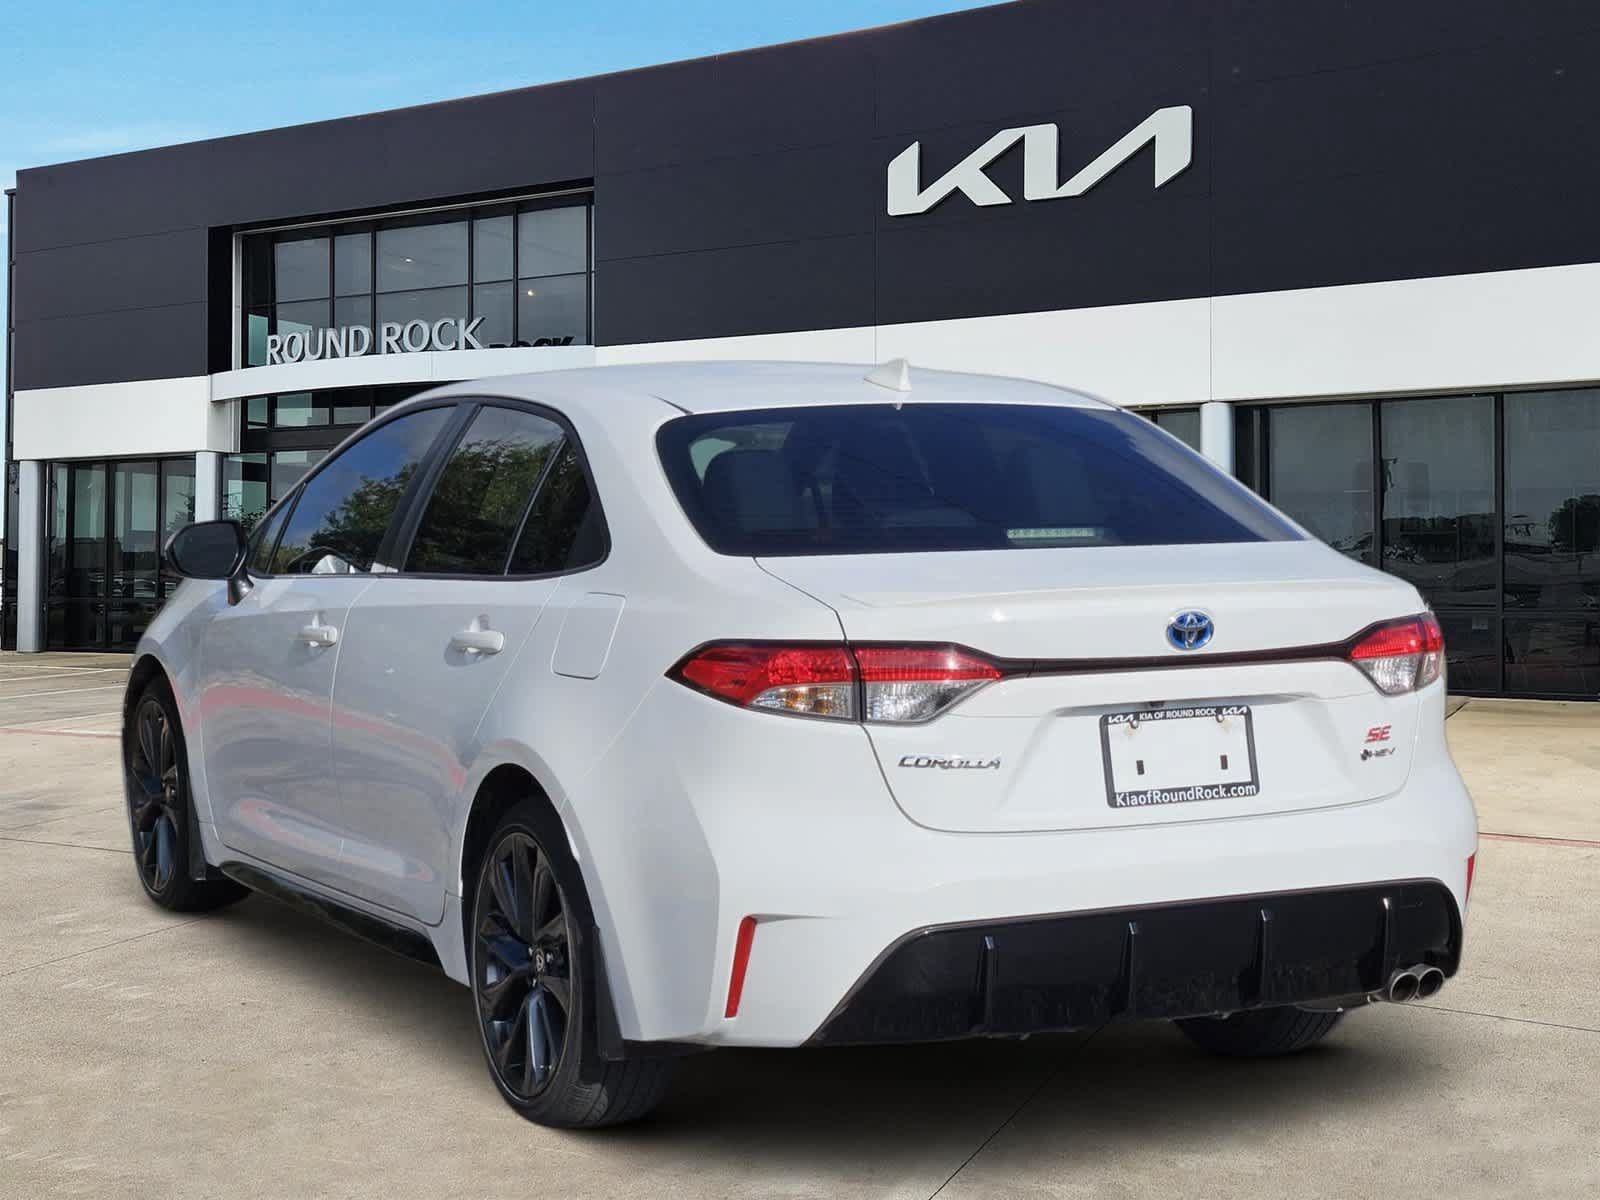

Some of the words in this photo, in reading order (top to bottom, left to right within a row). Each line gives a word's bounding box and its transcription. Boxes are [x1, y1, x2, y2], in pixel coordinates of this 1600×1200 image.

[887, 105, 1193, 216] KIA
[266, 324, 373, 365] ROUND
[380, 316, 484, 355] ROCK
[1139, 712, 1154, 721] KIA
[1154, 711, 1165, 719] OF
[1166, 709, 1194, 718] ROUND
[1195, 707, 1217, 717] ROCK
[1365, 724, 1392, 742] SE
[898, 756, 1001, 770] COROLLA
[1115, 784, 1257, 808] KiaofRoundRock.com
